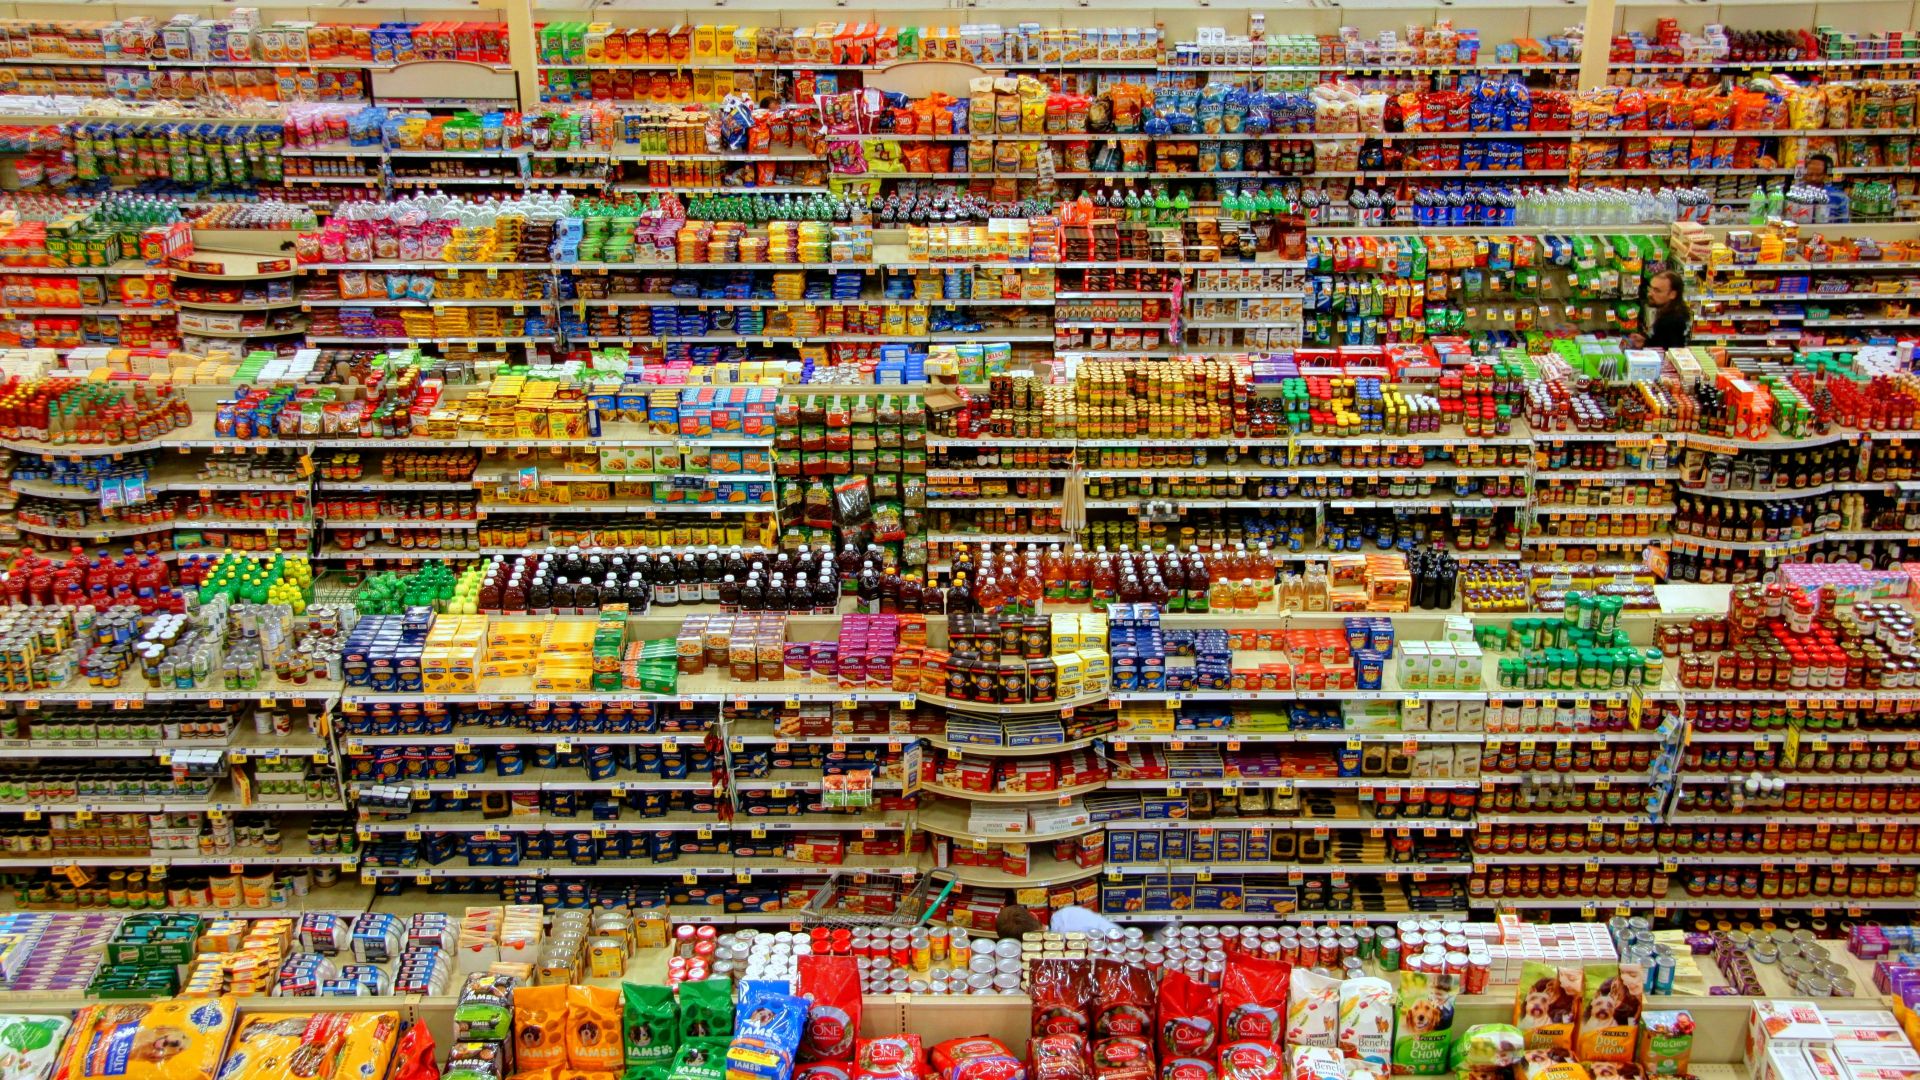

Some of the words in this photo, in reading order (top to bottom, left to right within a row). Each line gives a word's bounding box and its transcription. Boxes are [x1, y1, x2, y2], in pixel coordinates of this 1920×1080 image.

[812, 1025, 842, 1036] ONE
[1046, 1023, 1075, 1035] ONE
[1109, 1020, 1138, 1032] ONE
[1240, 1020, 1268, 1033] ONE
[740, 1027, 773, 1038] IAMS
[1596, 1036, 1618, 1046] DOG
[1653, 1040, 1668, 1048] DOG
[1669, 1039, 1688, 1047] CHOW
[519, 1047, 553, 1058] IAMS
[575, 1047, 609, 1057] IAMS
[627, 1046, 662, 1057] IAMS
[871, 1049, 900, 1058] ONE
[1105, 1047, 1135, 1056] ONE
[1410, 1048, 1443, 1059] CHOW
[1594, 1044, 1625, 1054] CHOW
[113, 1042, 128, 1072] ADULT
[1233, 1052, 1263, 1060] ONE
[676, 1066, 710, 1076] IAMS
[734, 1060, 756, 1071] IAMS
[1174, 1070, 1204, 1078] ONE
